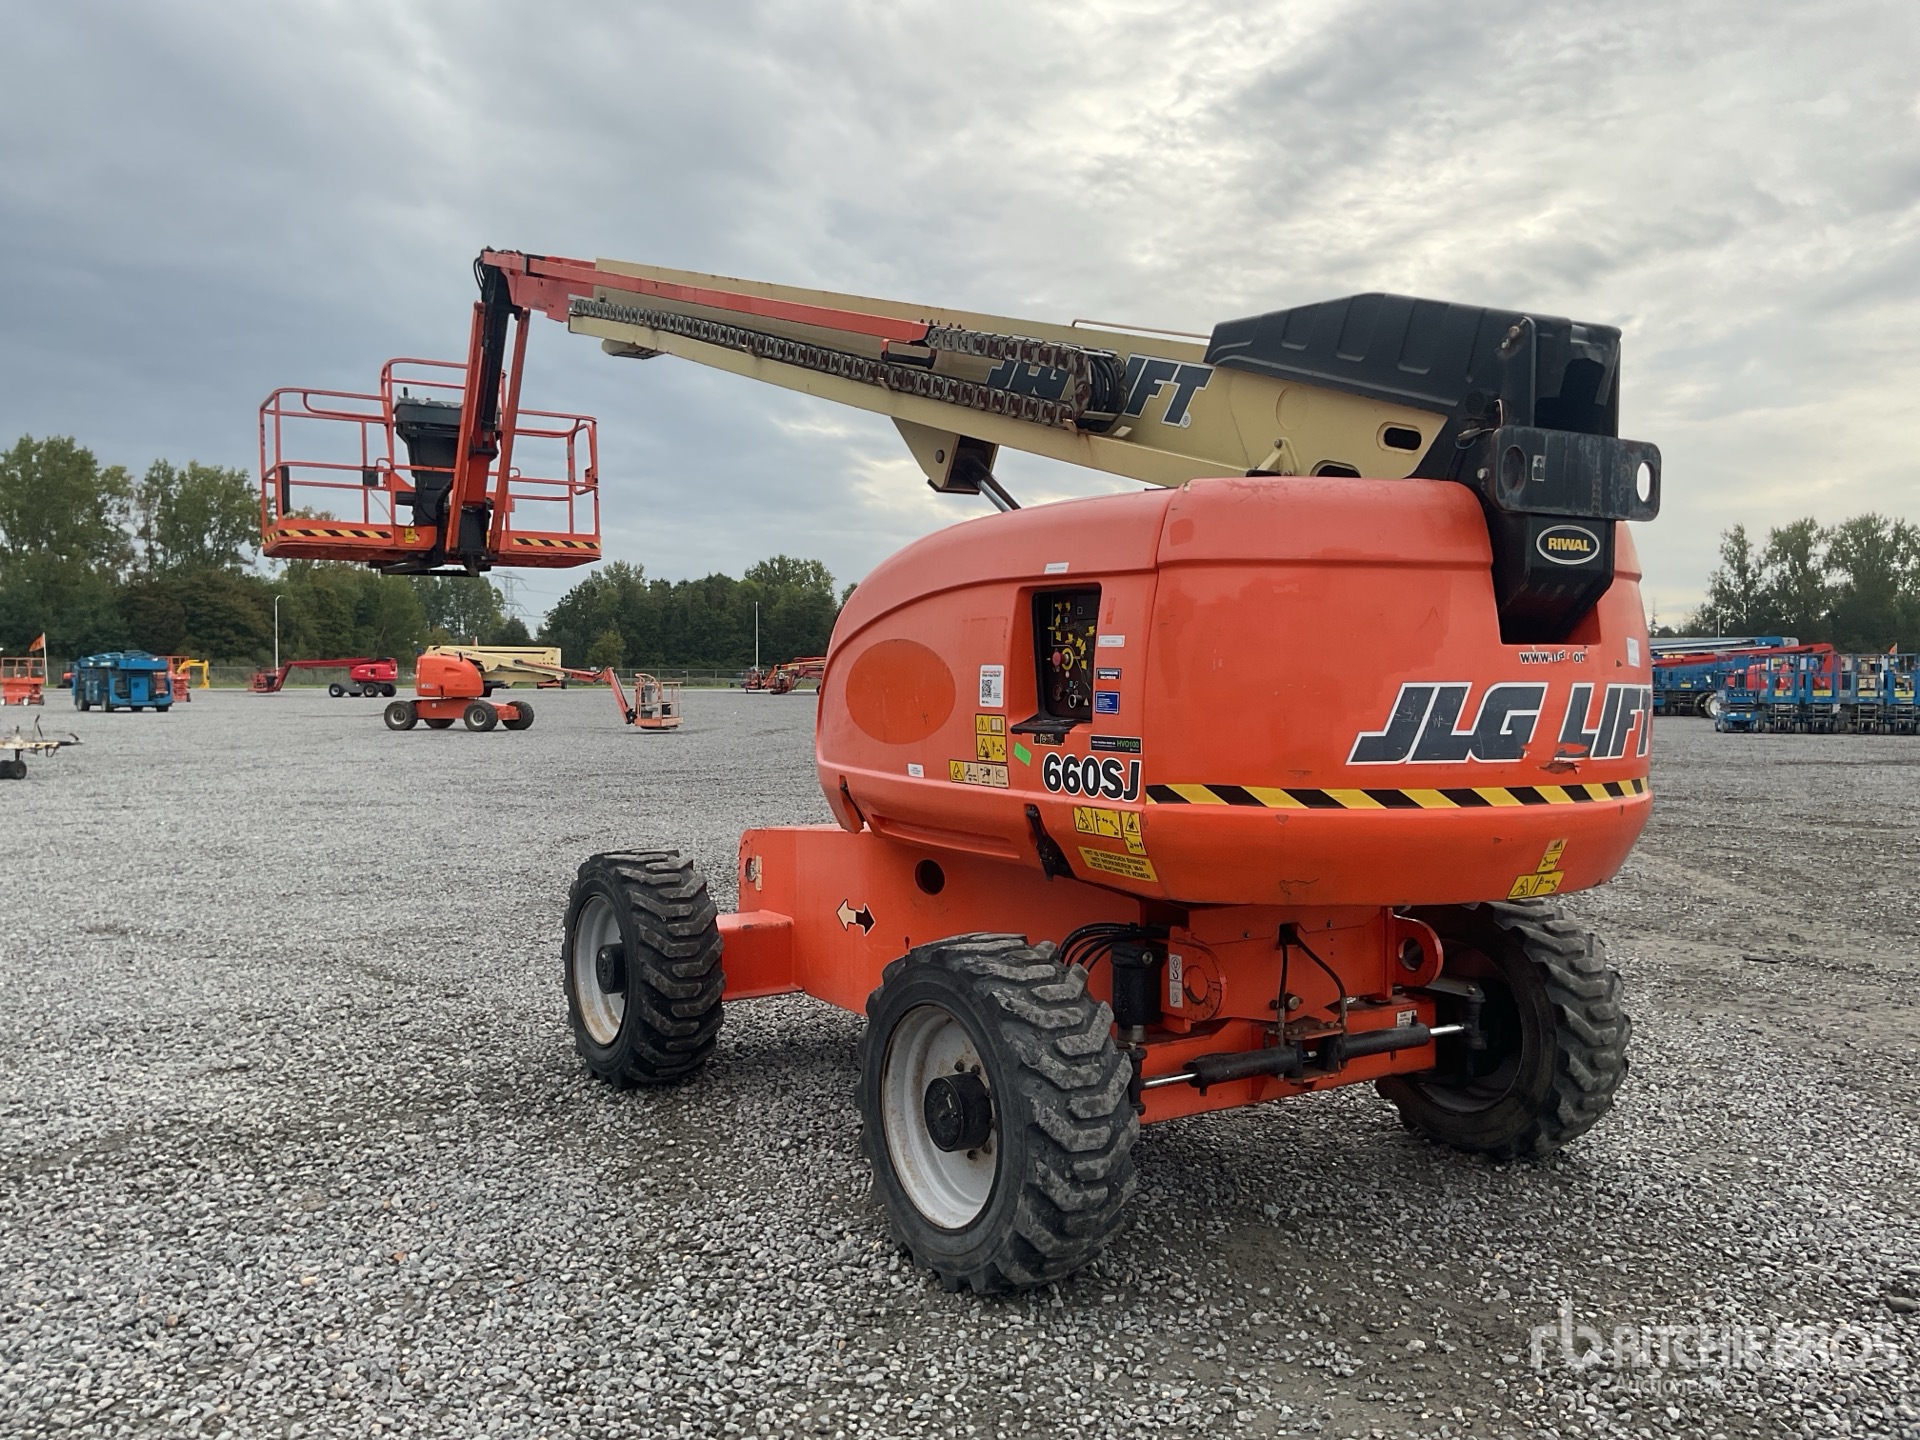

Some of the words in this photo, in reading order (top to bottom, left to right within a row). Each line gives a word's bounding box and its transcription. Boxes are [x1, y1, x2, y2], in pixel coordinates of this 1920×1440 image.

[1548, 537, 1591, 552] RIWAL
[1346, 682, 1549, 766] JLG
[1116, 739, 1140, 749] HVO100
[1043, 753, 1141, 802] 660SJ
